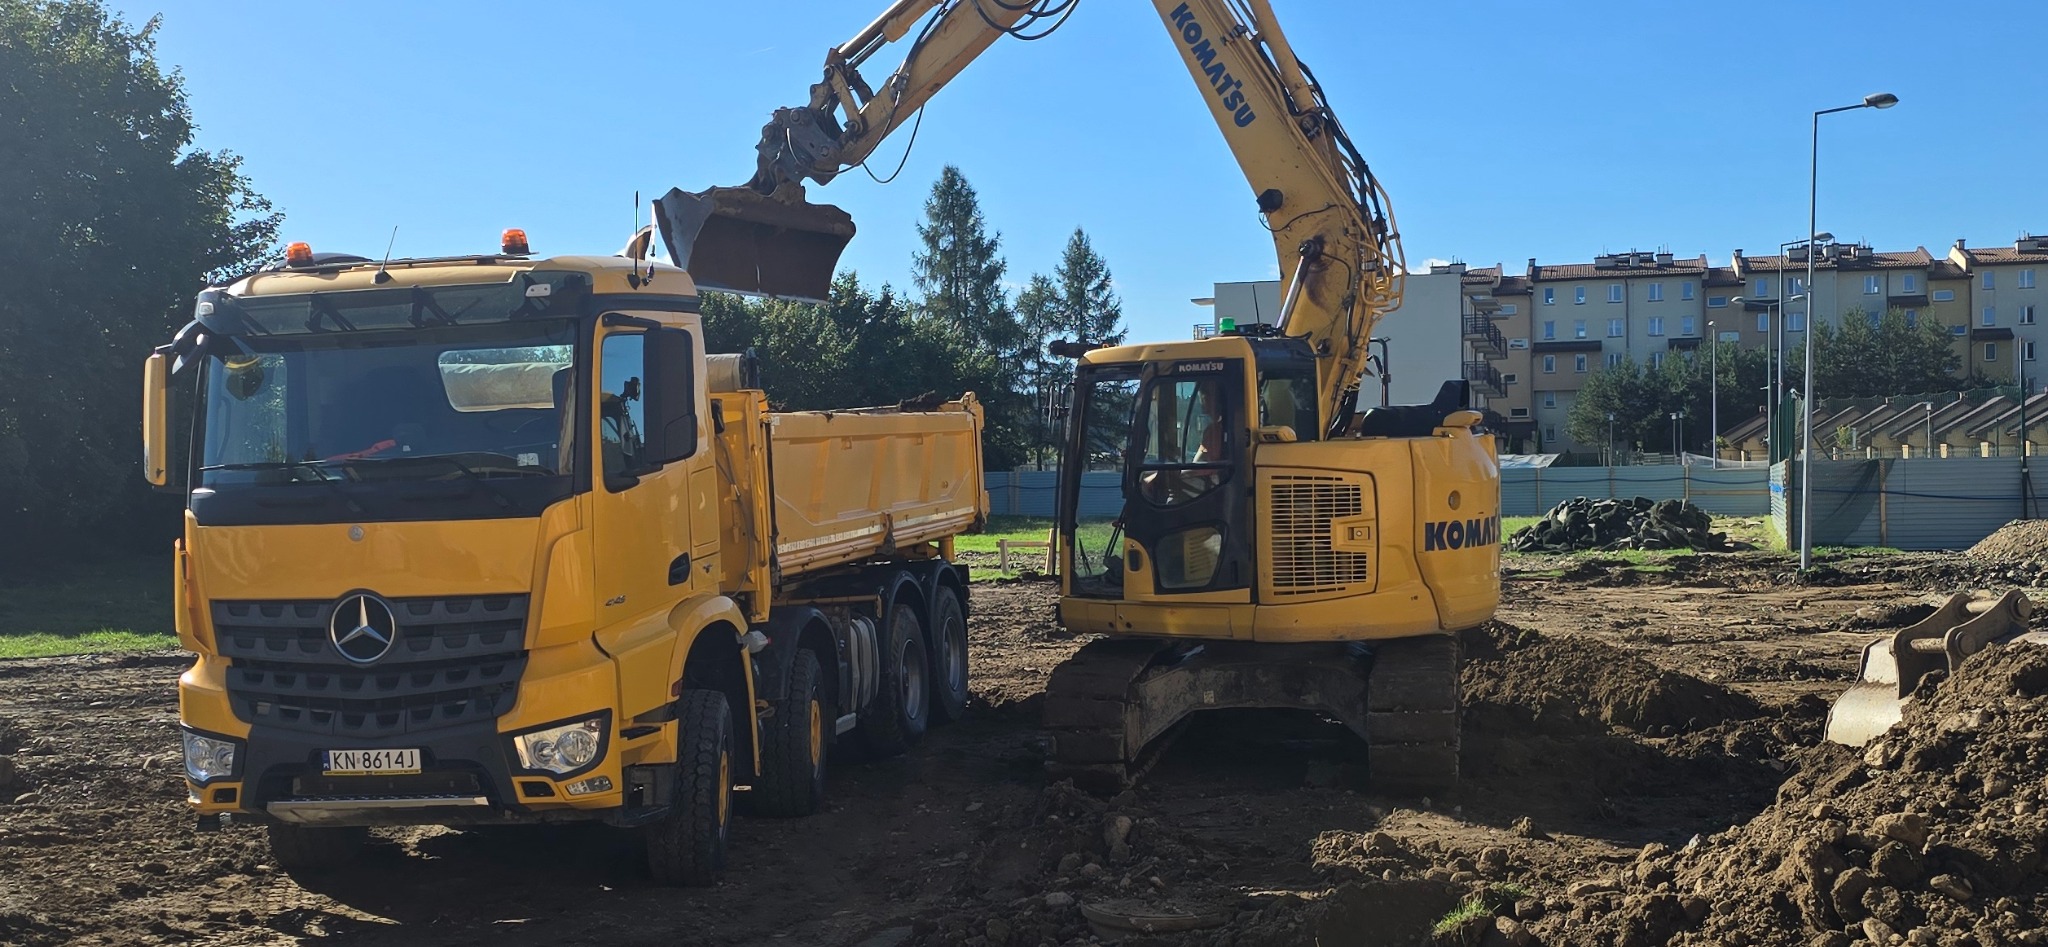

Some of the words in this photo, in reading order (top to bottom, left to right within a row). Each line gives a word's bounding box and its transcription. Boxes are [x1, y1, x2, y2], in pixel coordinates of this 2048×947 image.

[1170, 2, 1256, 128] KOMATSU
[1178, 361, 1224, 372] KOMATSU
[1425, 516, 1499, 551] KOMAT
[333, 752, 356, 769] KN
[362, 751, 414, 769] 8614J
